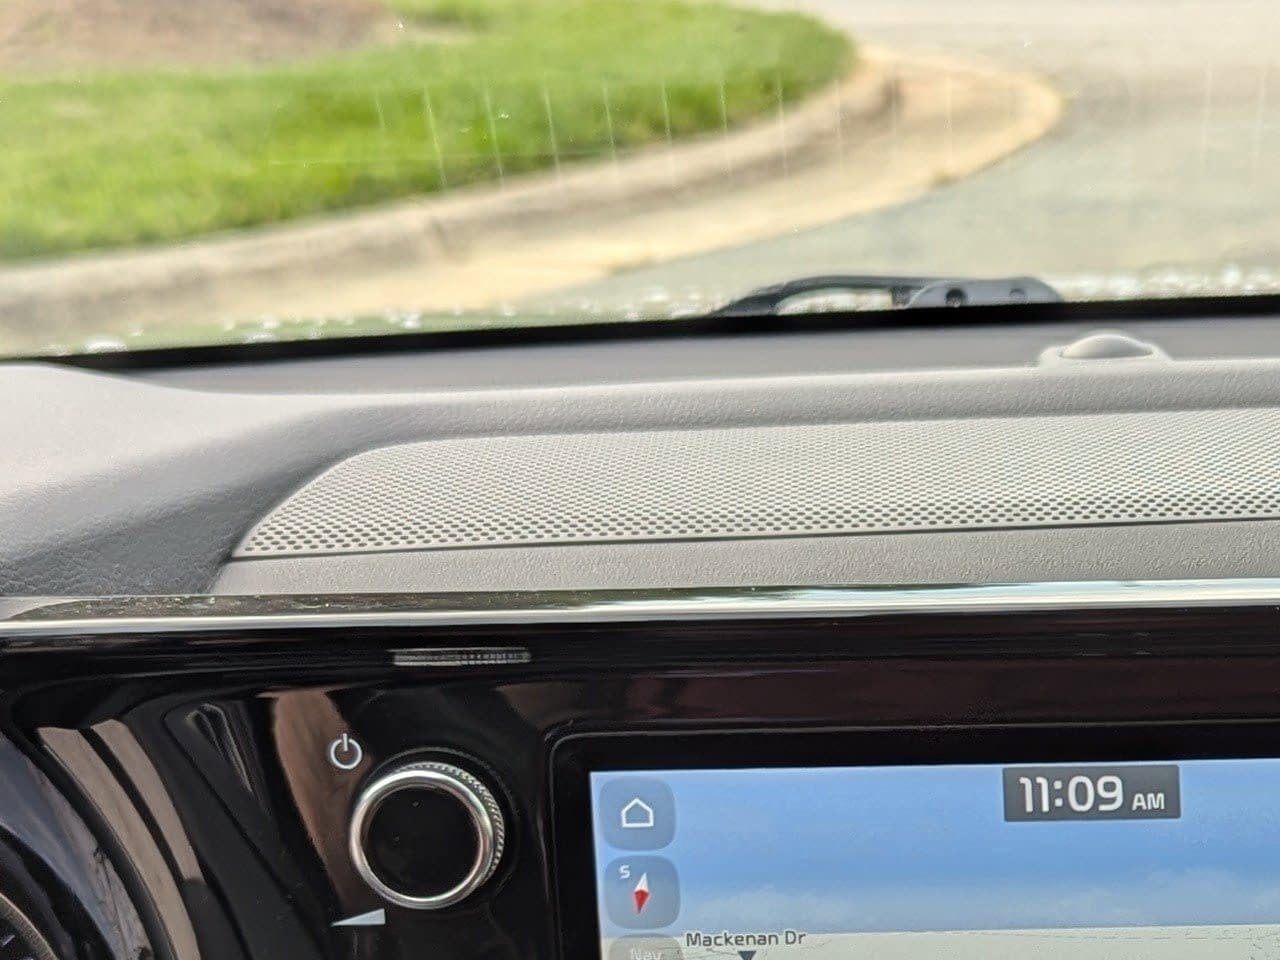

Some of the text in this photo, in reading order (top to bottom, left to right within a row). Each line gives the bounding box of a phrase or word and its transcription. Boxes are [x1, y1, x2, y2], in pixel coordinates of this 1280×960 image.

[1019, 775, 1166, 812] 11:09 AM
[686, 930, 806, 948] Mackenan Dr
